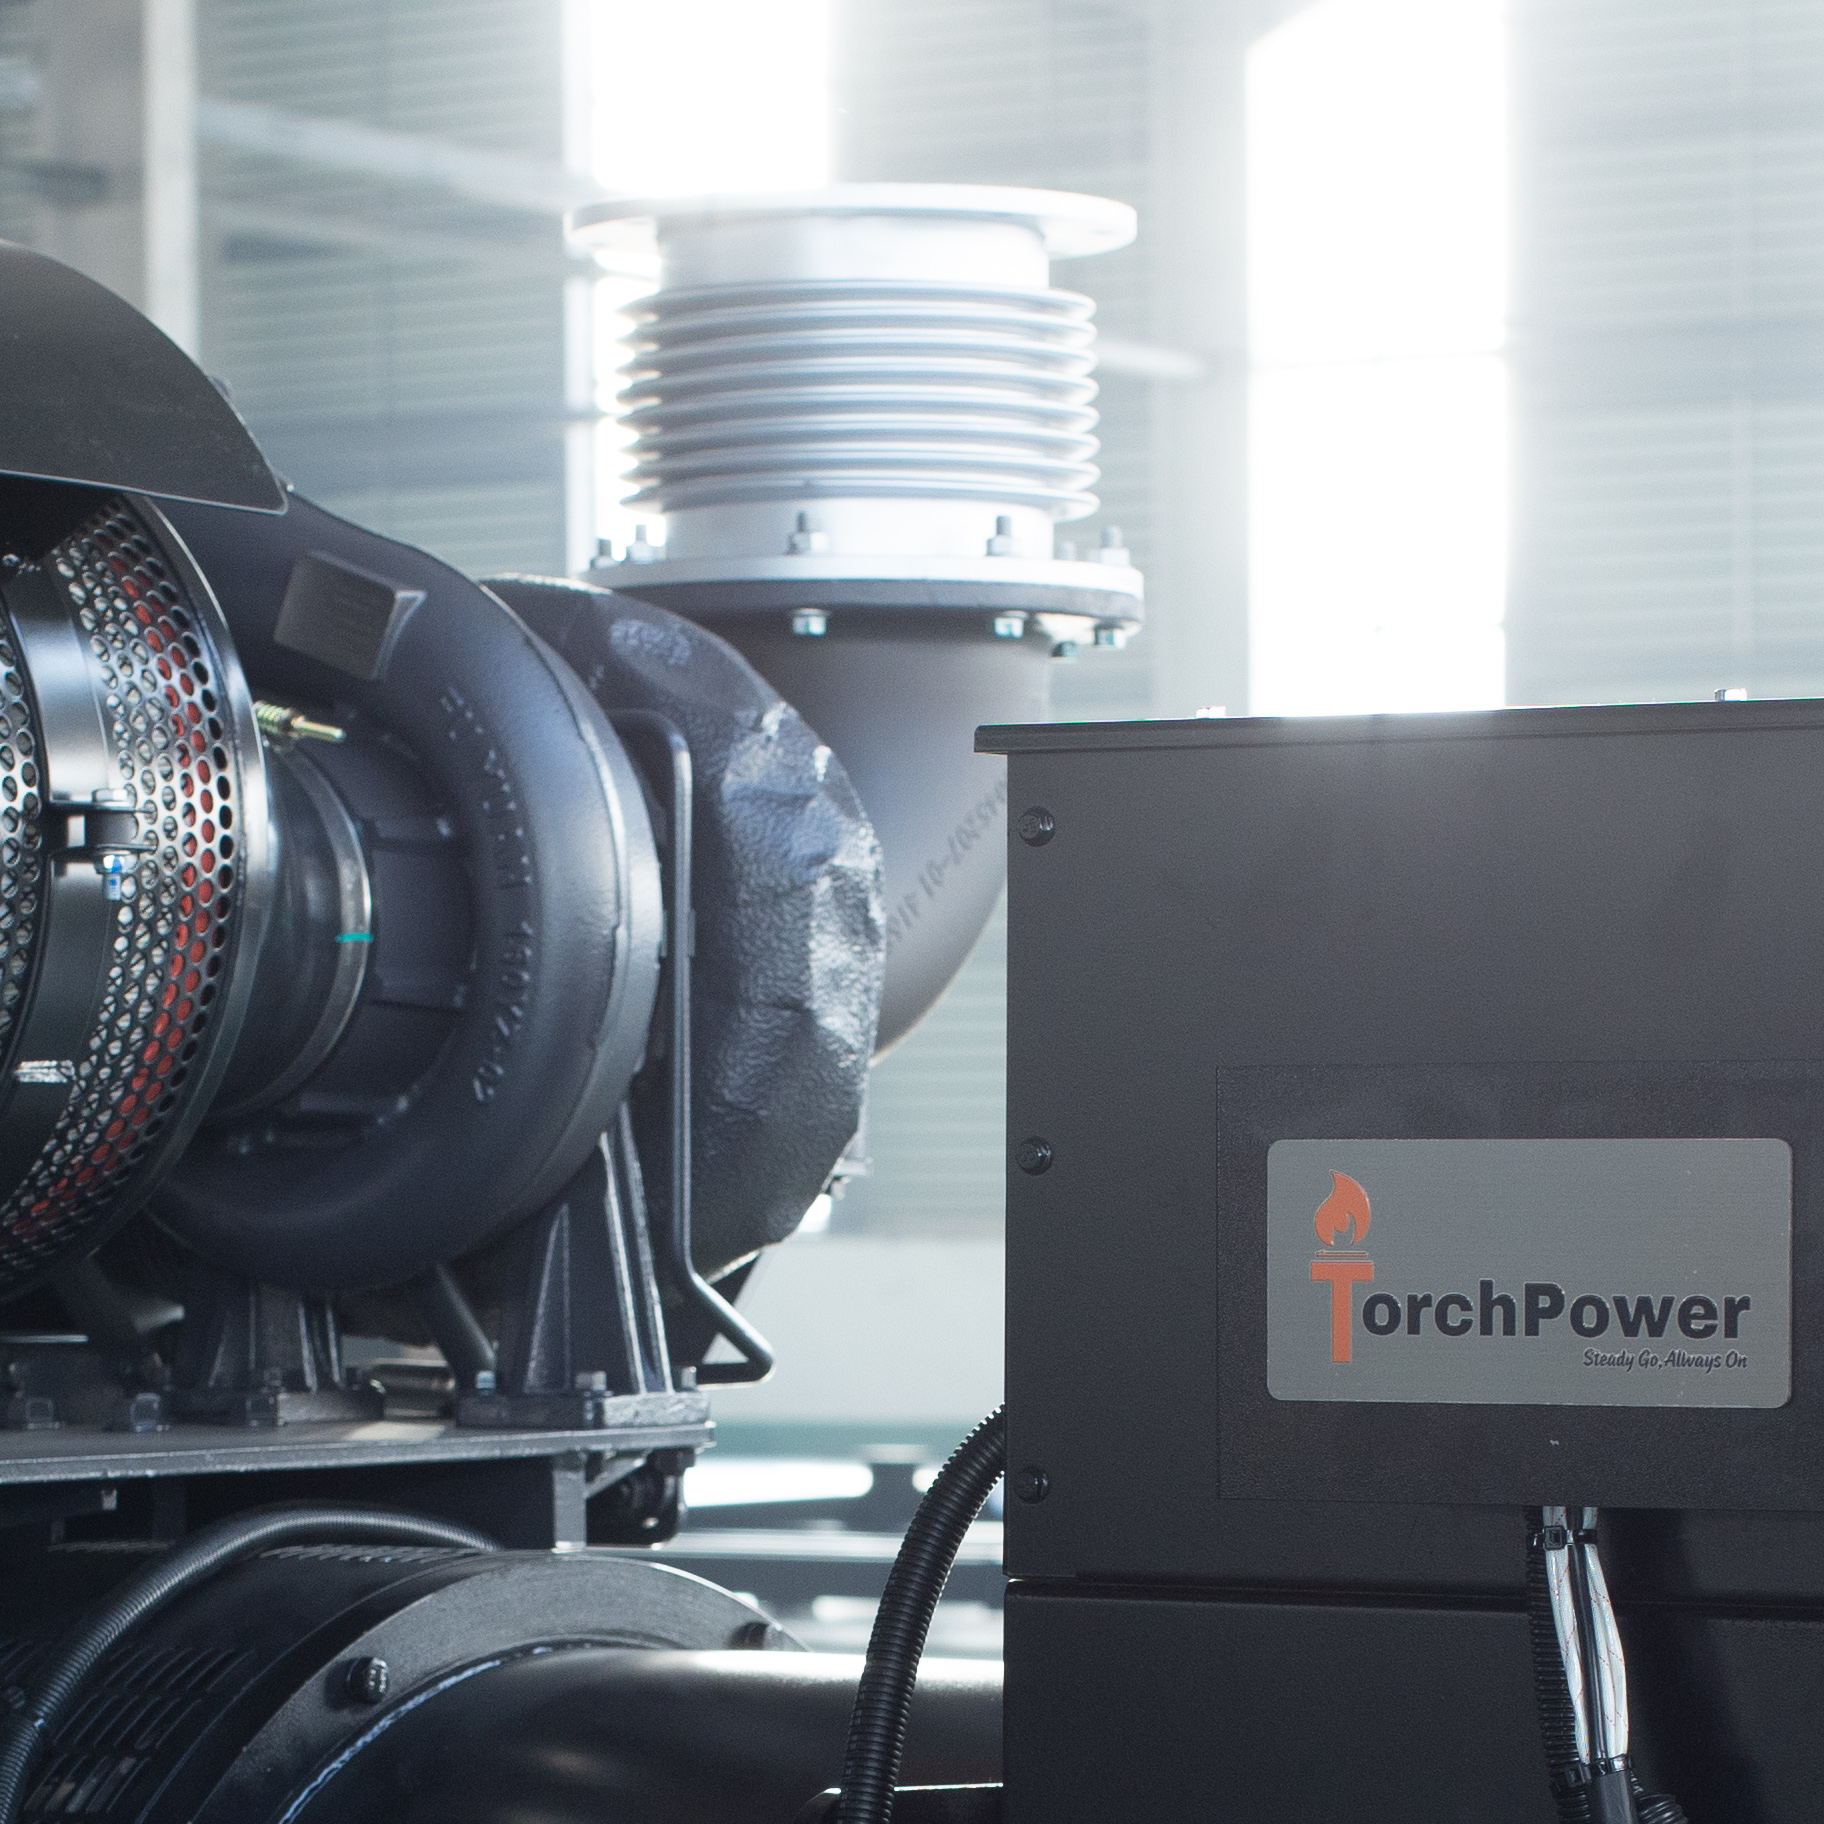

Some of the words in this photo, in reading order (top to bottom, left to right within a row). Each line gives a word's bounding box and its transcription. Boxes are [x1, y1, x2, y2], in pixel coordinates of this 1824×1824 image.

[1310, 1261, 1751, 1364] TorchPower
[1583, 1347, 1635, 1372] Steady
[1725, 1349, 1748, 1369] On
